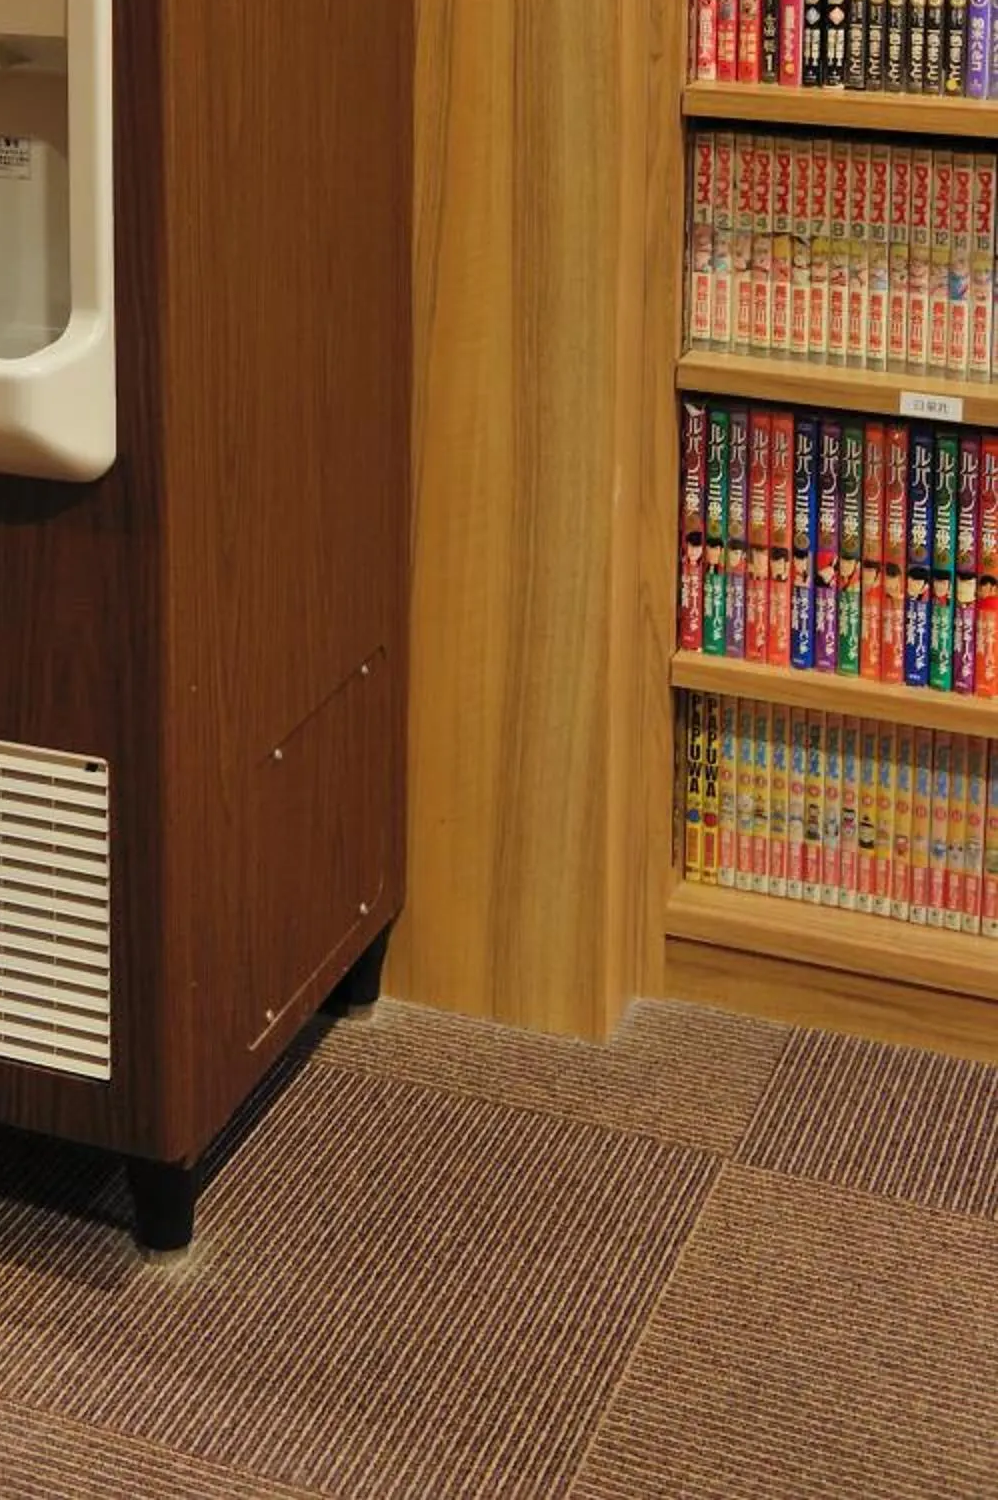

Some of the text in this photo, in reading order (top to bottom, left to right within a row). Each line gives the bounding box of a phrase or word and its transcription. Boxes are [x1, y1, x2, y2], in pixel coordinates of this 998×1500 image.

[698, 208, 708, 223] 1
[716, 215, 728, 229] 2
[756, 216, 767, 229] 4
[776, 217, 788, 231] 5
[812, 222, 824, 235] 7
[833, 223, 844, 237] 8
[852, 223, 864, 238] 9
[869, 225, 885, 239] 10
[893, 228, 906, 241] 11
[912, 229, 927, 244] 13
[934, 231, 949, 245] 12
[976, 236, 990, 249] 15
[688, 695, 701, 795] PAPUWA
[705, 698, 719, 798] PAPUWA
